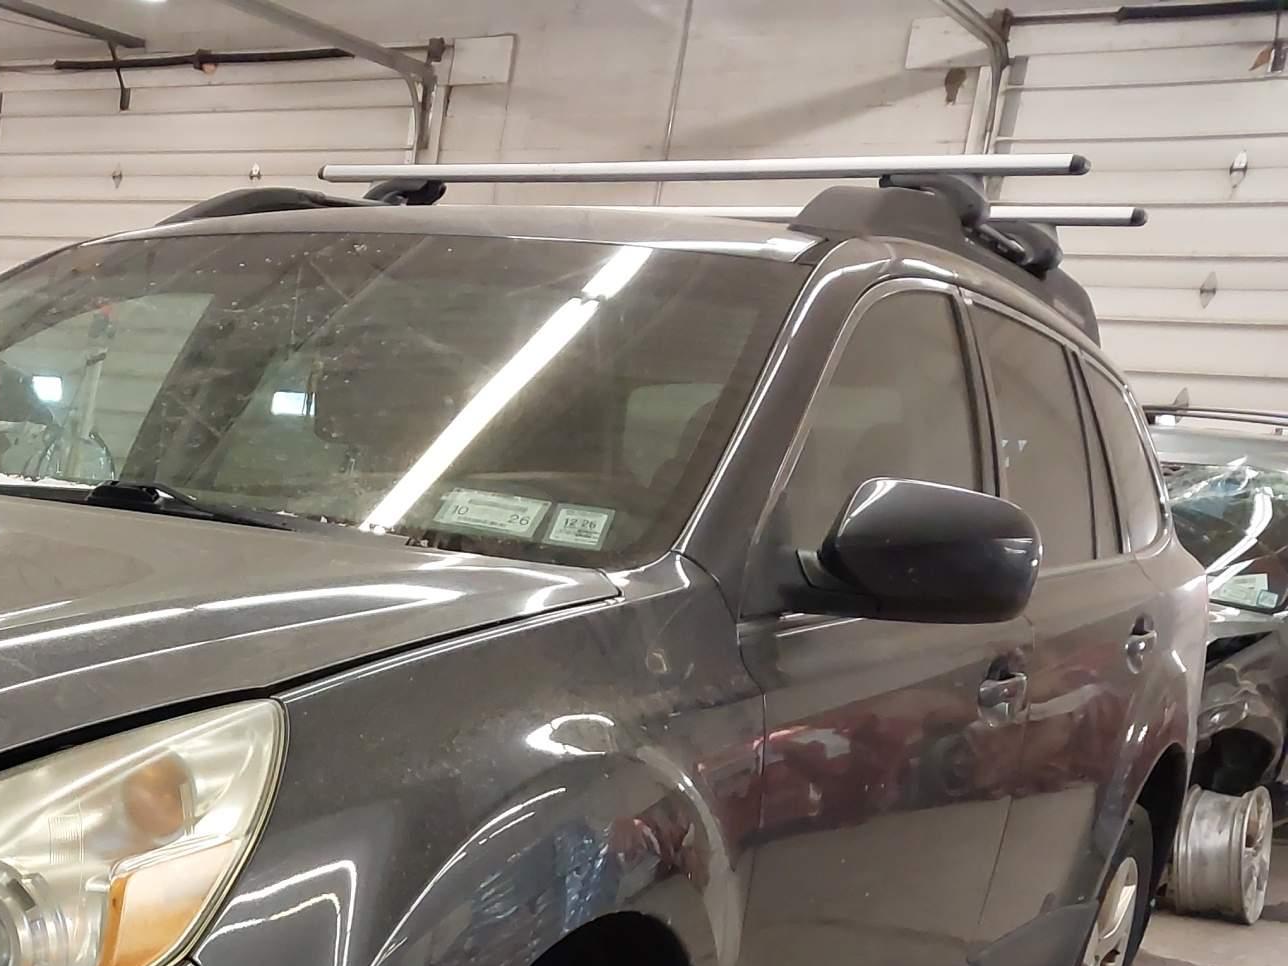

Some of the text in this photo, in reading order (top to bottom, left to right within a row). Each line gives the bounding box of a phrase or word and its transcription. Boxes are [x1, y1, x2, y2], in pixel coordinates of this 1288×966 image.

[452, 504, 469, 516] 10
[508, 513, 530, 526] 26
[563, 518, 597, 530] 12 26
